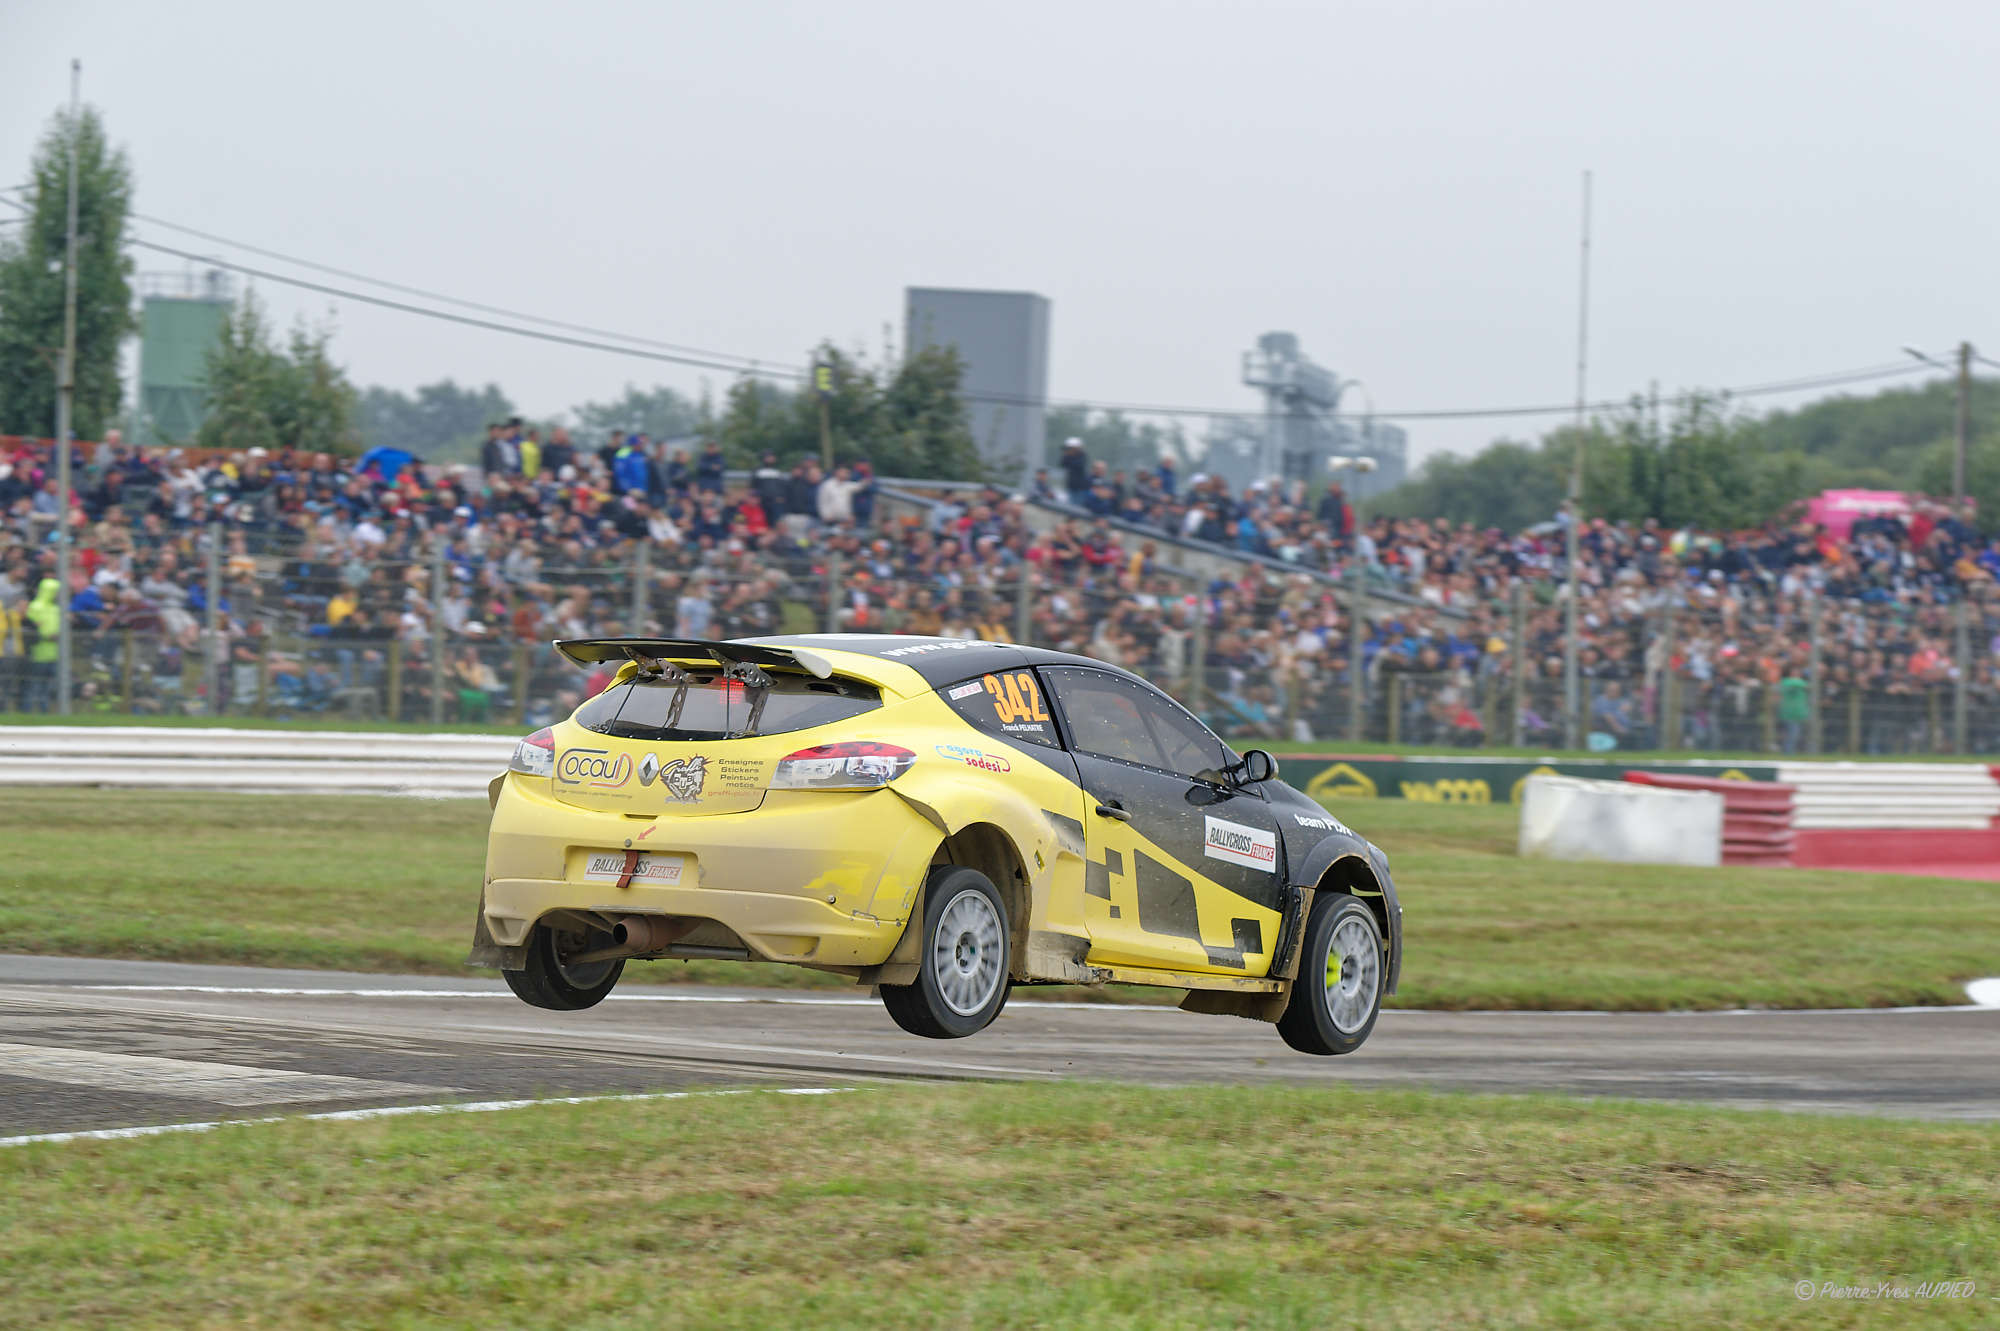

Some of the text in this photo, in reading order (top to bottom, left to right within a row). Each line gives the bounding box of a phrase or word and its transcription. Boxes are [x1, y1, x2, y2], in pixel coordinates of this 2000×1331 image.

[984, 673, 1049, 723] 342
[718, 758, 764, 766] Enseignes
[720, 773, 760, 782] Peinture
[1210, 827, 1273, 860] RALLYCROSS FRANCE
